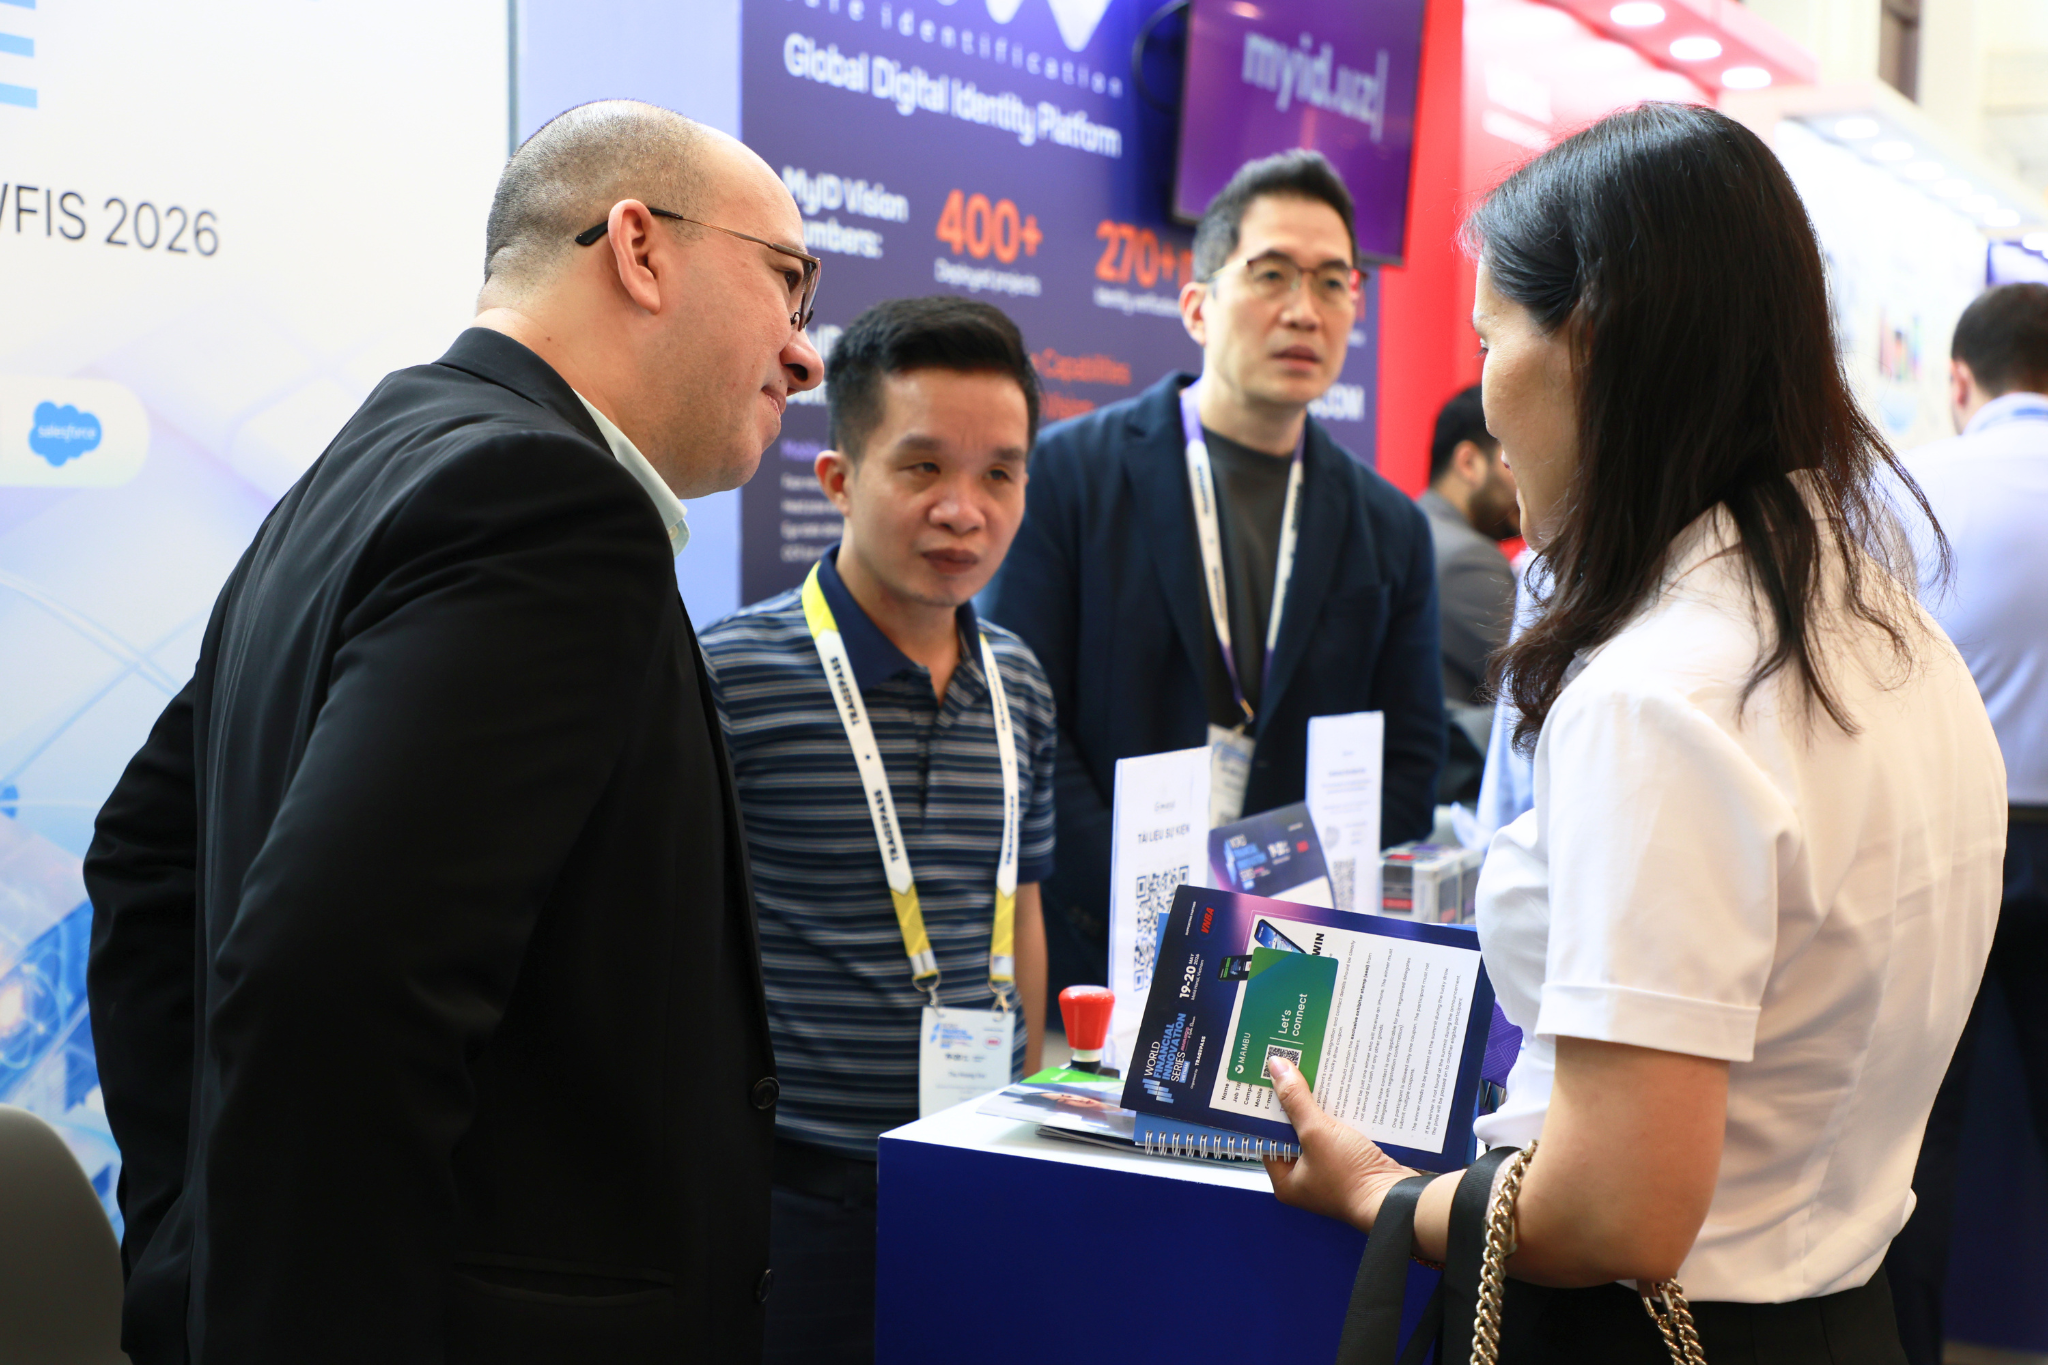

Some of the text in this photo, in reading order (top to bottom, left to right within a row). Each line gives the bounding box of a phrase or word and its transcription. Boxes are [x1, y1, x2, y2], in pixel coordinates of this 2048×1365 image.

[784, 32, 869, 94] Global
[871, 55, 950, 117] Digital
[950, 76, 1036, 147] Identity
[843, 176, 910, 224] Vision
[103, 196, 219, 257] 2026
[802, 215, 884, 260] umbers:
[935, 187, 1044, 265] 400+
[1095, 218, 1177, 289] 270+
[37, 424, 97, 444] salesforce
[1201, 907, 1214, 933] VNBA
[1312, 932, 1325, 956] WIN
[1180, 966, 1196, 997] 19-20
[1278, 1010, 1291, 1034] Let's
[1292, 994, 1307, 1036] connect
[1144, 1041, 1160, 1076] WORLD
[1153, 1024, 1174, 1078] FINANCIAL
[1162, 1013, 1187, 1080] INNOVATION
[1238, 1033, 1250, 1063] MAMBU
[1171, 1052, 1185, 1081] SERIES
[1180, 1062, 1189, 1081] VIETNAM
[1221, 1083, 1229, 1100] Name
[1244, 1083, 1254, 1105] Compa
[1255, 1088, 1263, 1107] Mobile
[1265, 1090, 1274, 1109] E-mail
